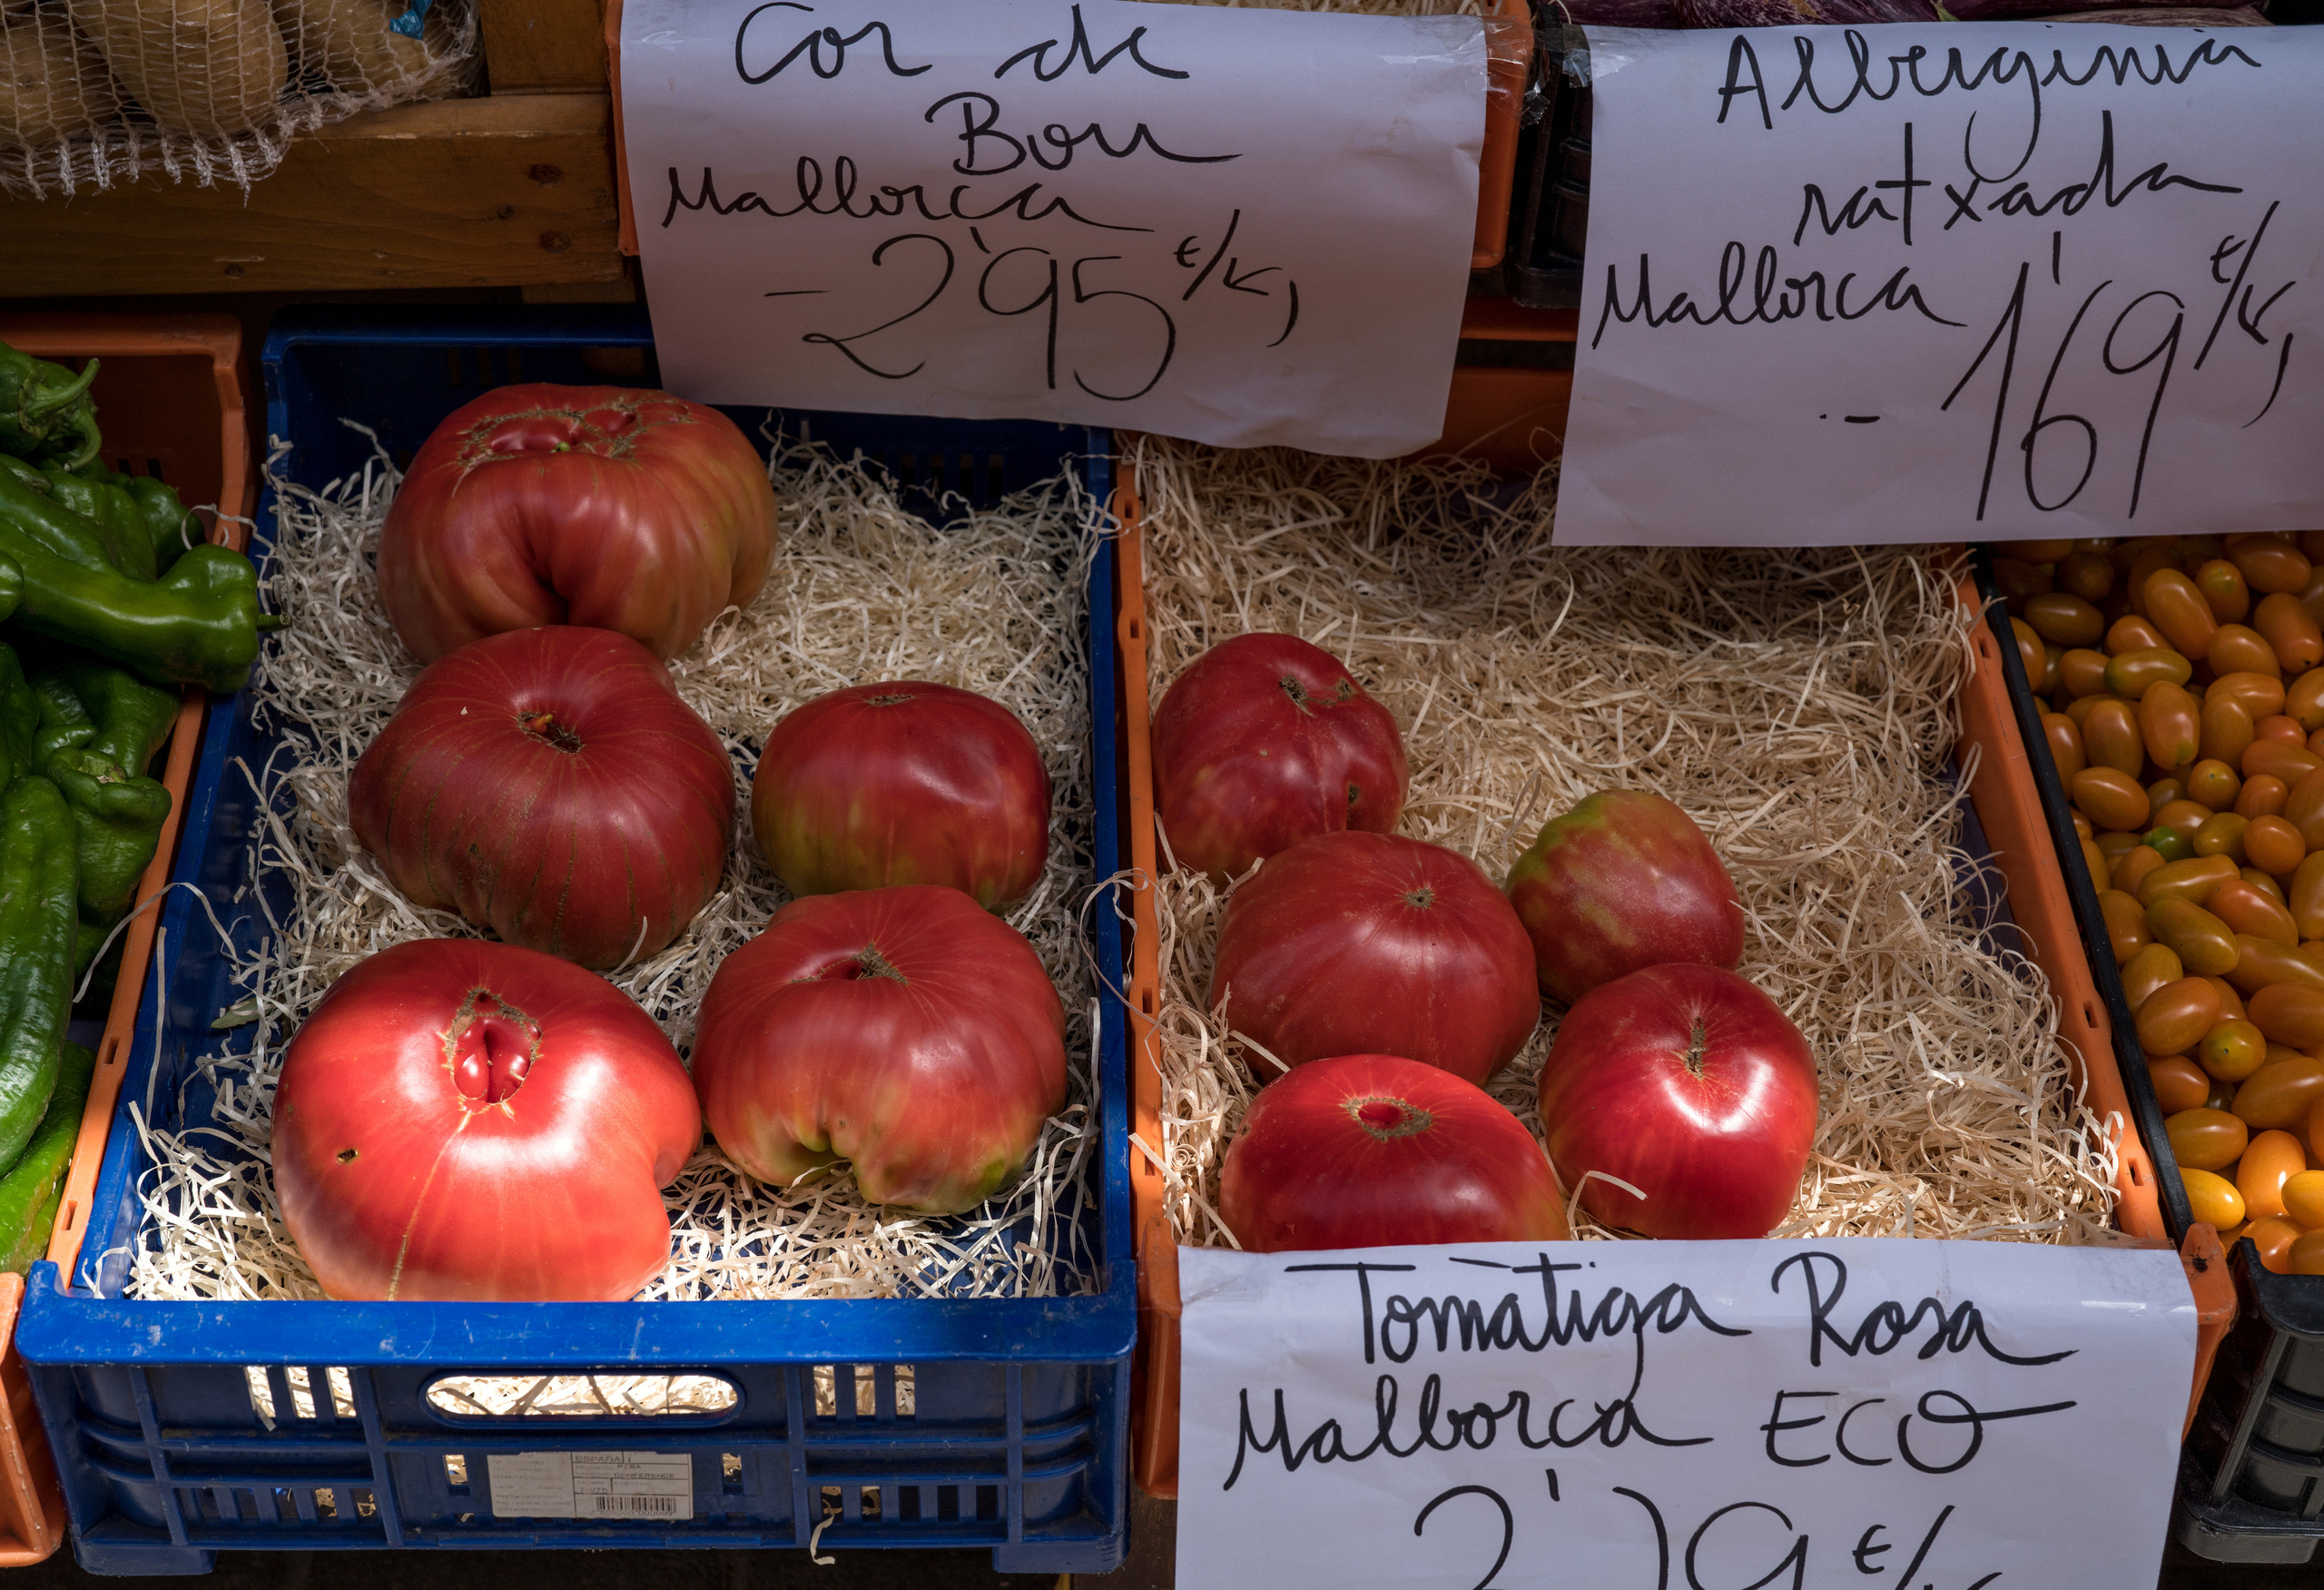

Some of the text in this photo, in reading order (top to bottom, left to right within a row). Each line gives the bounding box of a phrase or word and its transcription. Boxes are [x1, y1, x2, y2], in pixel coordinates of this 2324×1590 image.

[735, 2, 1190, 84] Cor de
[662, 156, 1155, 232] Mallorca
[1794, 110, 2244, 246] ratxada
[1592, 242, 1968, 350] Mallorca
[1772, 1252, 2079, 1367] Rosa
[575, 1455, 622, 1463] ESPAÑA
[1224, 1374, 2078, 1490] Mallorca ECO
